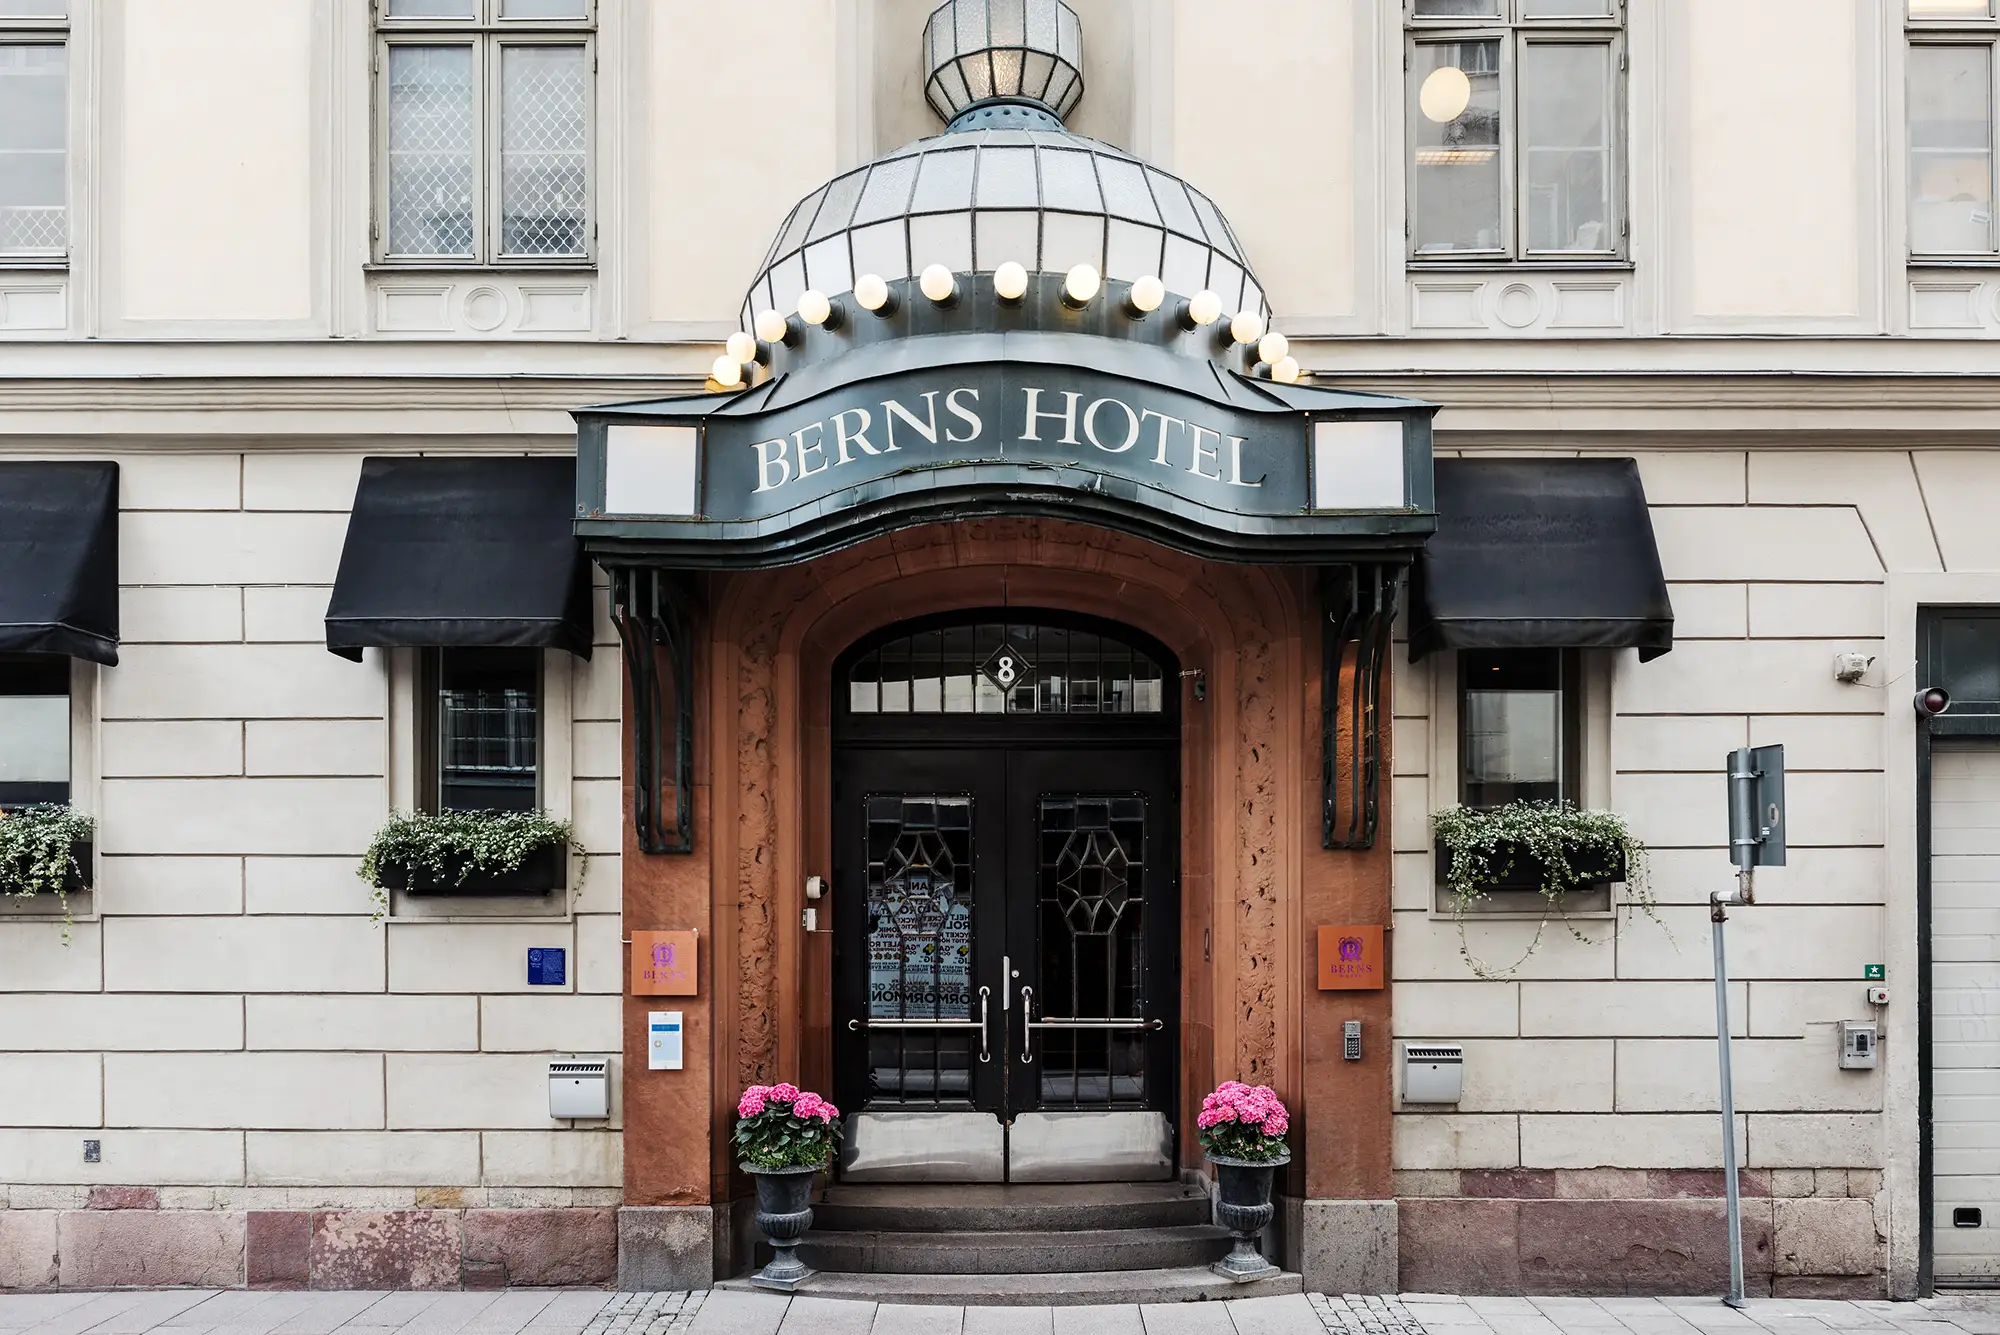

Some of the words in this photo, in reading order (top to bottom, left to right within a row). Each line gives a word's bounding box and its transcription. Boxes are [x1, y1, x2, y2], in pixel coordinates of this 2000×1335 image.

[750, 388, 983, 494] BERNS
[1018, 388, 1267, 488] HOTEL
[998, 656, 1015, 682] 8
[1331, 964, 1372, 974] BERNS
